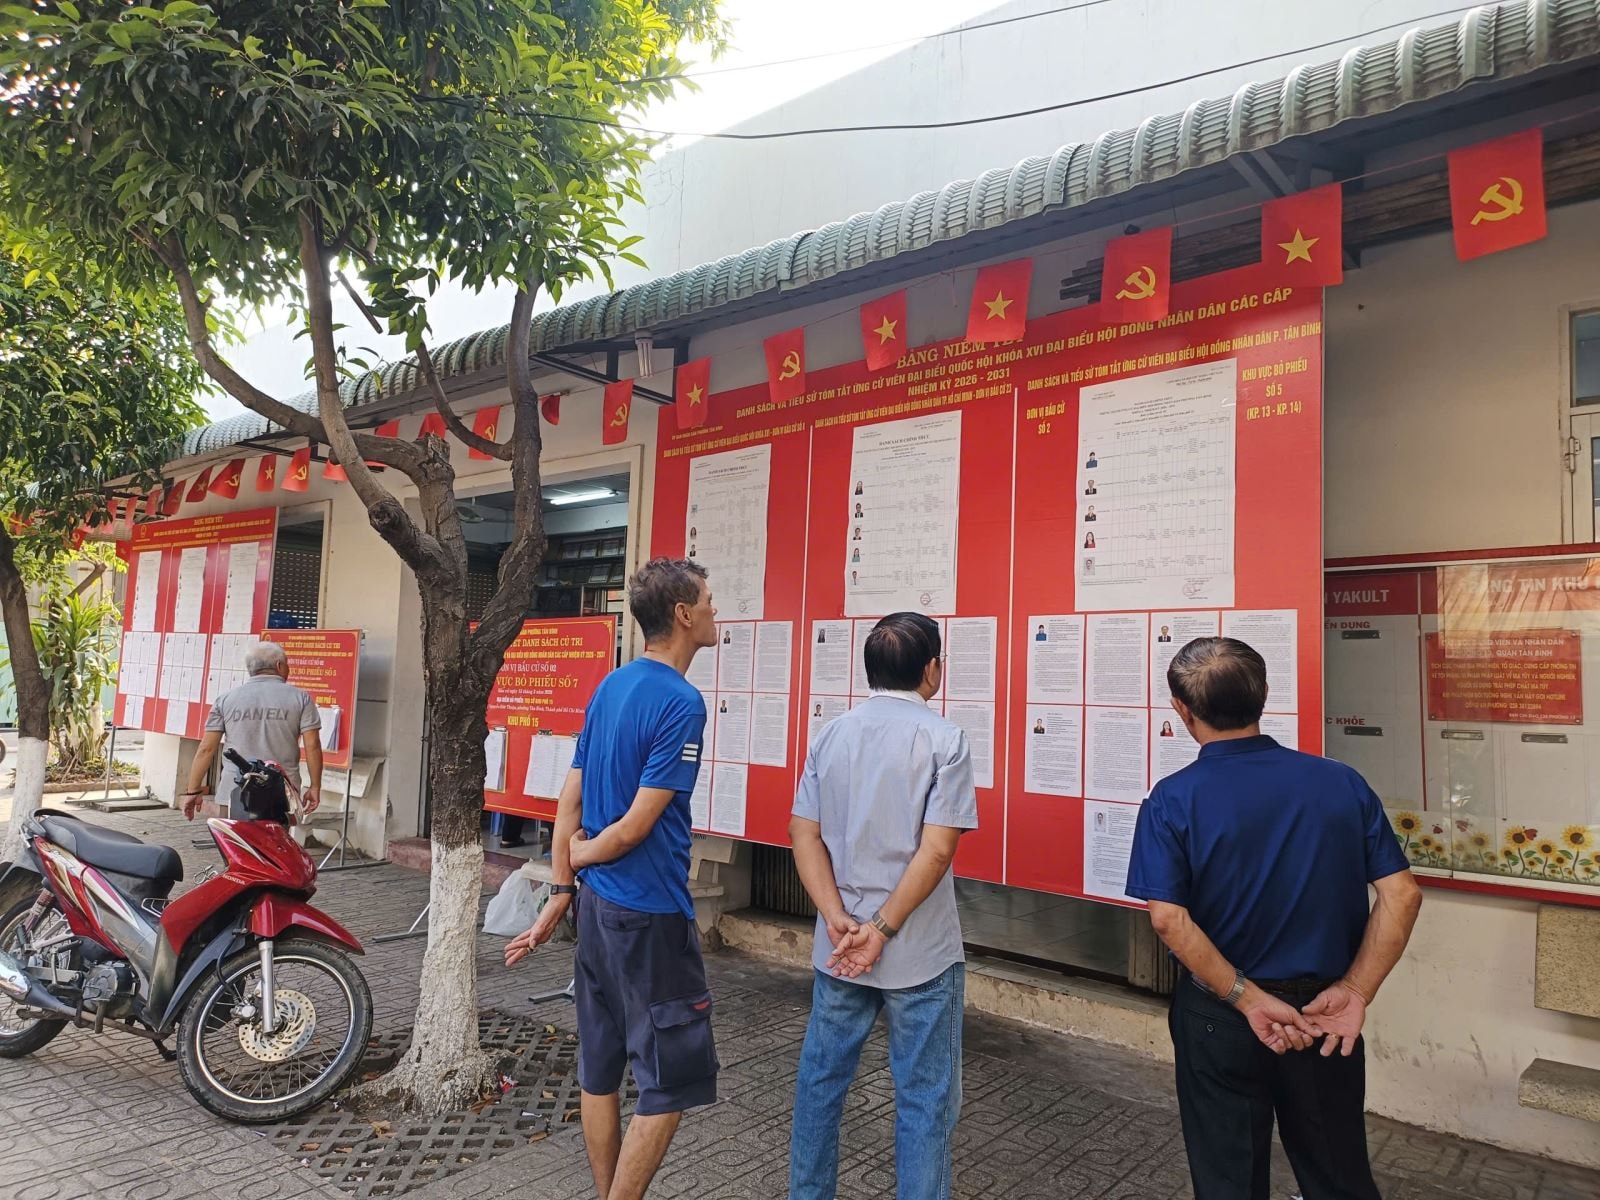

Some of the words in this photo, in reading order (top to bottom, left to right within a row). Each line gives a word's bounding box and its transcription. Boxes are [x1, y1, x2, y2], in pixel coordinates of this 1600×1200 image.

[736, 408, 755, 418] DANH
[757, 402, 775, 413] SÁCH
[806, 390, 818, 403] SỬ
[819, 388, 835, 400] TÓM
[837, 384, 851, 397] TẮT
[885, 372, 906, 387] VIÊN
[907, 370, 923, 383] ĐẠI
[925, 364, 946, 379] BIỂU
[948, 358, 974, 374] QUỐC
[976, 355, 993, 369] HỘI
[995, 348, 1023, 365] KHÓA
[1026, 344, 1043, 359] XVI
[1046, 339, 1065, 354] ĐẠI
[1067, 329, 1094, 349] BIỂU
[1096, 327, 1117, 344] HỘI
[1158, 309, 1194, 329] NHÂN
[1197, 302, 1226, 320] DÂN
[1230, 294, 1258, 312] CÁC
[1262, 285, 1293, 305] CẤP
[896, 348, 939, 369] BẢNG
[1027, 377, 1043, 391] DANH
[1044, 372, 1060, 388] SÁCH
[1061, 370, 1069, 384] VÀ
[1070, 365, 1083, 383] TIỂU
[1084, 366, 1094, 380] SỬ
[1094, 362, 1108, 378] TÓM
[1110, 360, 1120, 375] TẮT
[1122, 357, 1136, 373] ỨNG
[1137, 355, 1146, 369] CỬ
[1148, 351, 1164, 367] VIÊN
[1165, 350, 1176, 366] ĐẠI
[1178, 343, 1194, 361] BIỂU
[1196, 342, 1208, 359] HỘI
[1210, 336, 1230, 355] ĐỒNG
[1232, 333, 1253, 350] NHÂN
[1255, 329, 1271, 346] DÂN
[1273, 329, 1280, 342] P.
[1283, 323, 1299, 340] TÂN
[1301, 319, 1320, 337] BÌNH
[1242, 367, 1257, 381] KHU
[1258, 365, 1273, 381] VỰC
[1274, 360, 1284, 375] BỎ
[1285, 357, 1308, 374] PHIẾU
[908, 380, 938, 396] NHIỆM
[940, 378, 952, 391] KỲ
[954, 374, 978, 388] 2026
[986, 367, 1010, 382] 2031
[1266, 384, 1276, 397] SỐ
[1277, 384, 1282, 395] 5
[1027, 408, 1038, 419] ĐƠN
[1038, 407, 1044, 419] VỊ
[1045, 404, 1056, 416] BẦU
[1056, 402, 1065, 415] CỬ
[1246, 408, 1260, 421] (KP.
[1262, 406, 1270, 417] 13
[1277, 403, 1288, 415] KP.
[1290, 401, 1301, 414] 14)
[1038, 423, 1045, 434] SỐ
[1046, 424, 1050, 432] 2
[1551, 576, 1589, 591] KHU
[1333, 589, 1390, 604] YAKULT
[541, 637, 558, 646] SÁCH
[560, 635, 569, 646] CỬ
[571, 638, 583, 646] TRI
[511, 664, 516, 673] VỊ
[518, 660, 530, 672] BẦU
[531, 662, 540, 672] CỬ
[540, 661, 549, 672] SỐ
[496, 676, 513, 686] VỰC
[515, 674, 526, 686] BỎ
[529, 674, 557, 688] PHIẾU
[558, 675, 572, 688] SỐ
[573, 679, 578, 688] 7
[508, 716, 518, 725] KHU
[519, 714, 530, 726] PHỐ
[532, 718, 539, 727] 15
[1336, 716, 1365, 725] KHỎE
[223, 874, 245, 885] HONDA
